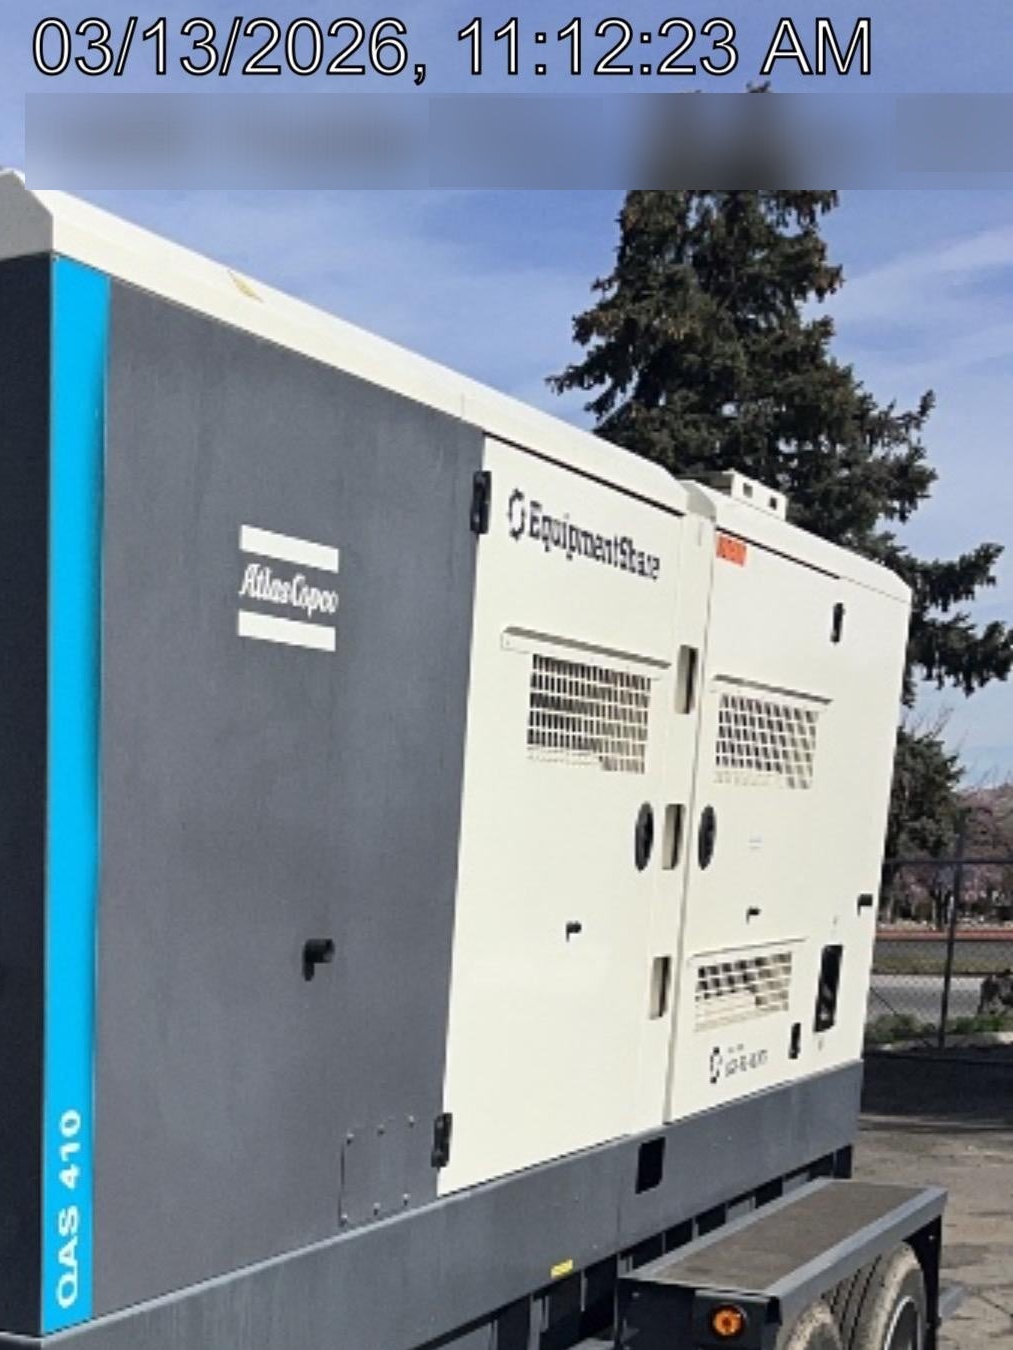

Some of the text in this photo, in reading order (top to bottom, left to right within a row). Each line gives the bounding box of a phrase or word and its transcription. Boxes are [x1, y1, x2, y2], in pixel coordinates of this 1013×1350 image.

[239, 562, 339, 618] Atlas Copco
[56, 1109, 81, 1309] QAS 410
